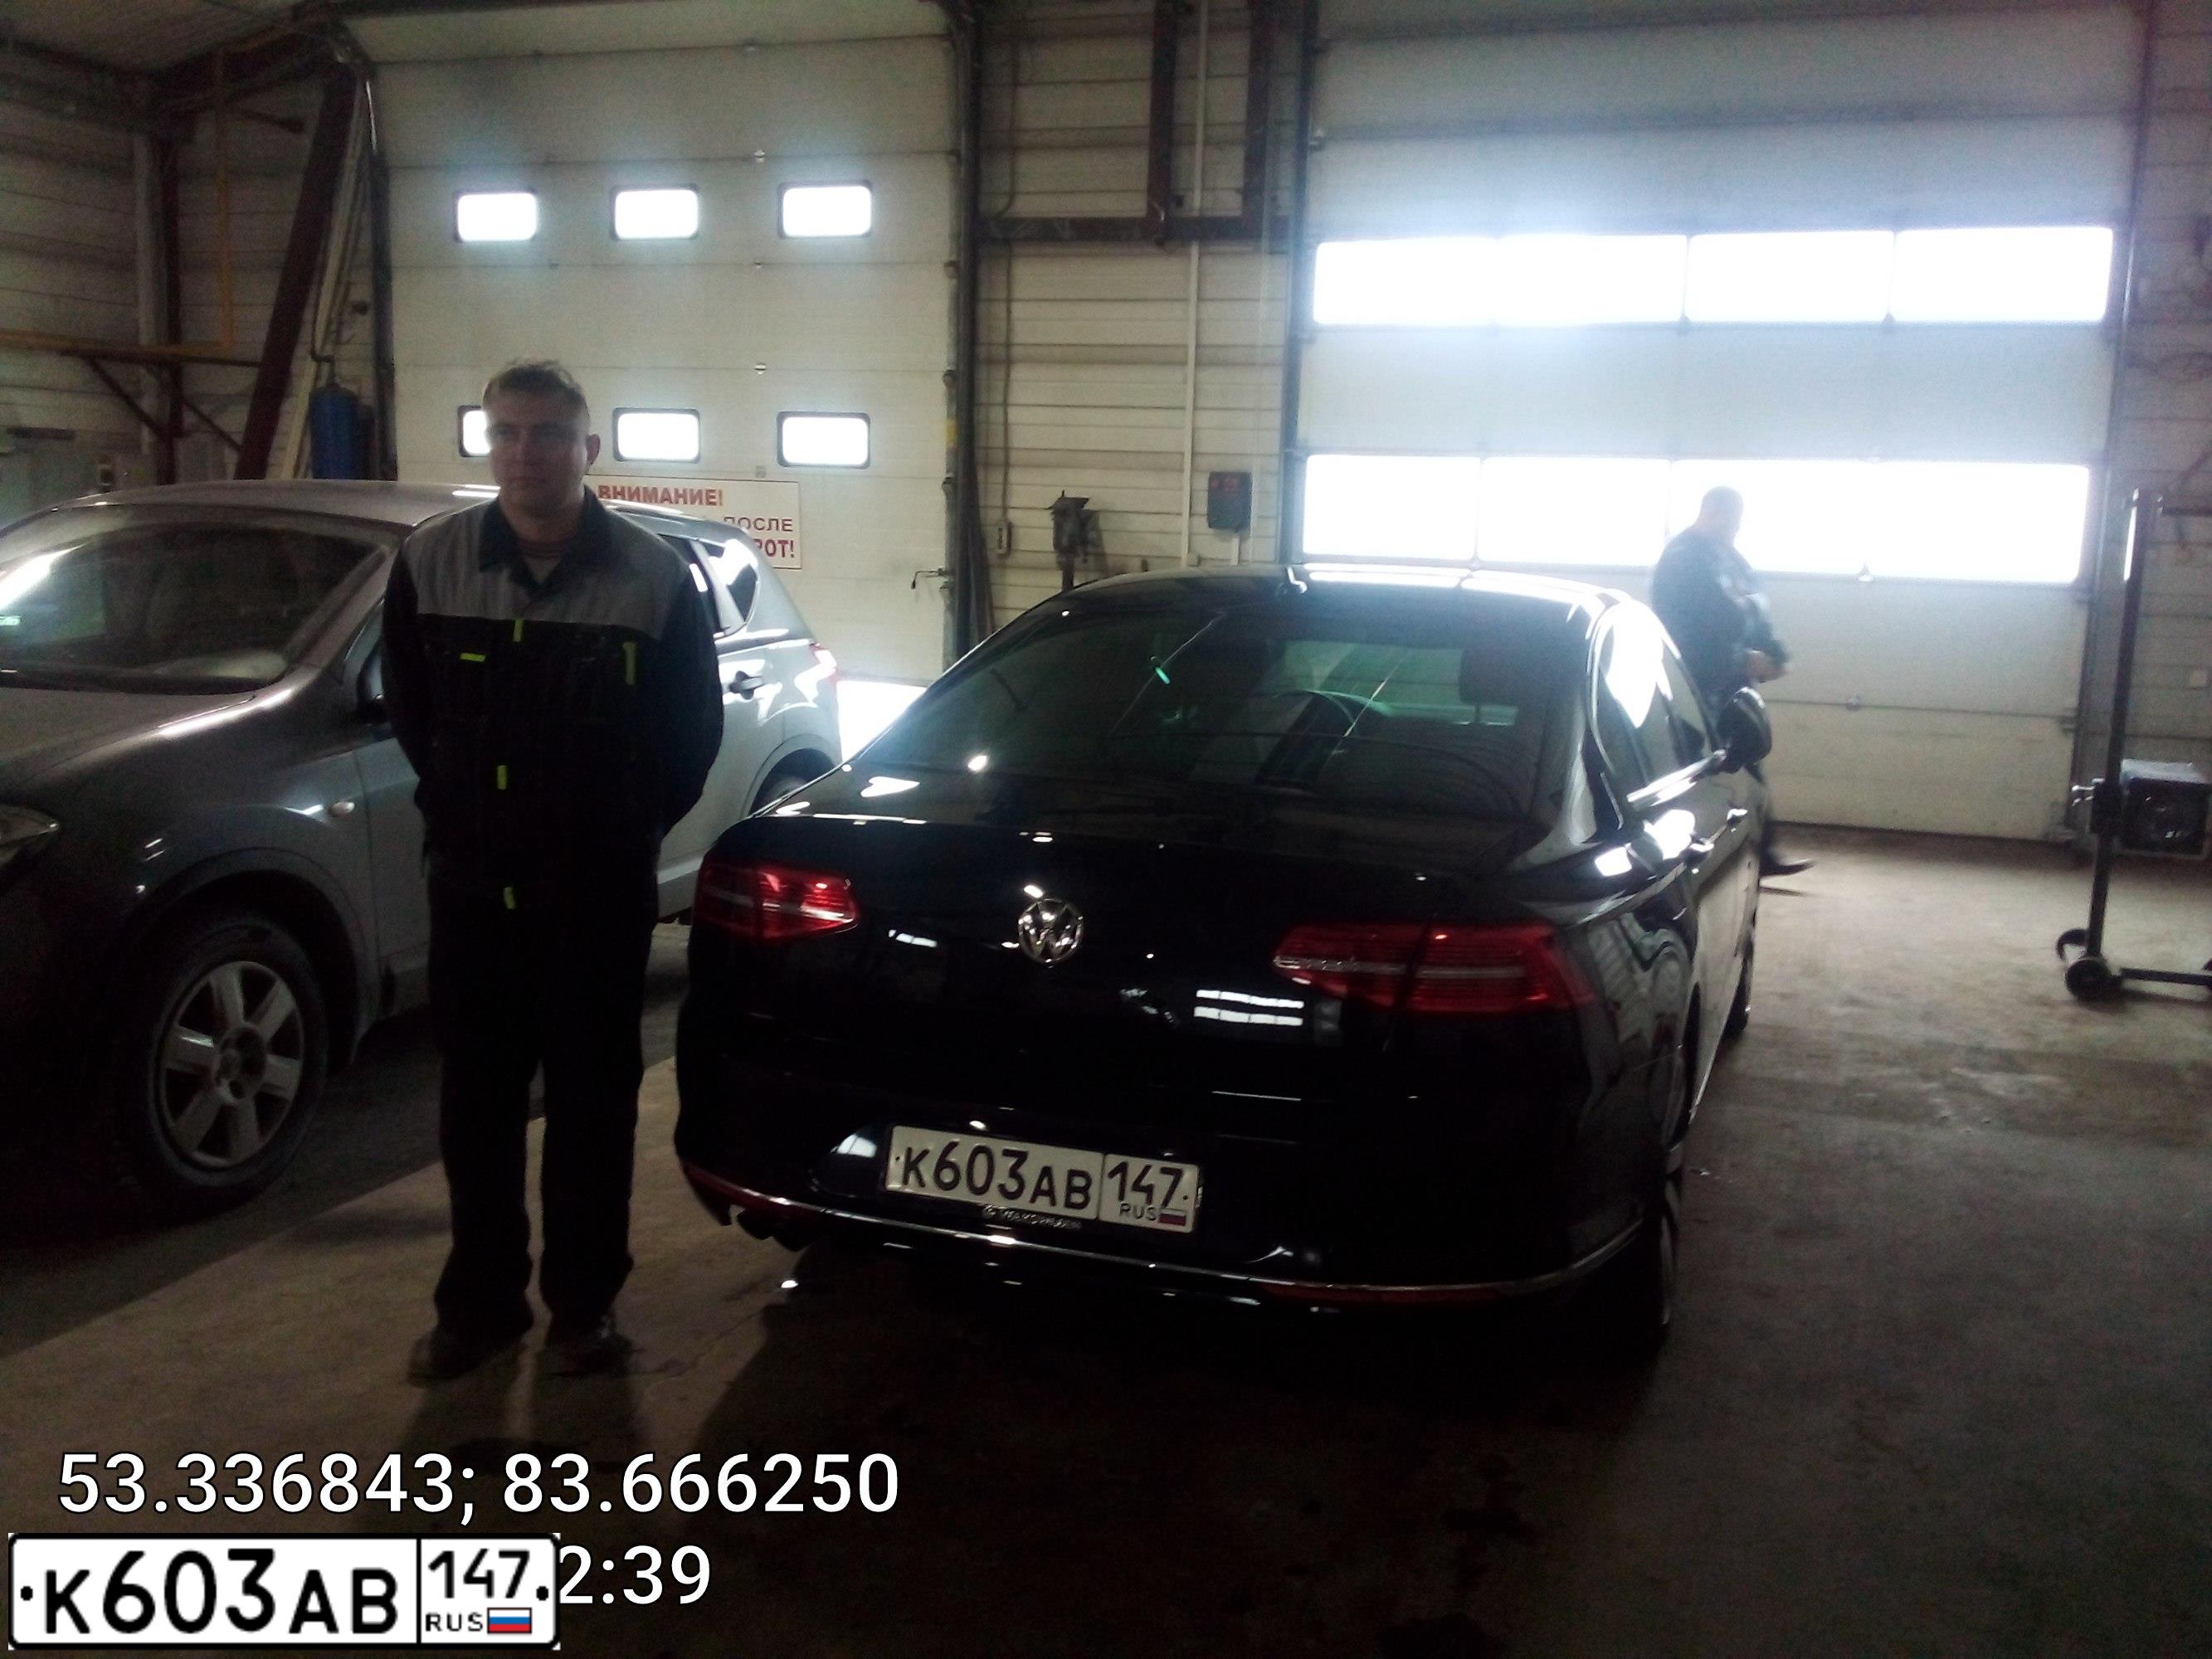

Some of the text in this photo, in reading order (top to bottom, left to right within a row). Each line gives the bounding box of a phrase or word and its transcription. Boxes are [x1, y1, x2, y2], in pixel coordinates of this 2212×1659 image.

[597, 484, 724, 507] ВНИМАНИЕ!
[903, 1140, 1183, 1209] К603АВ 147
[1119, 1203, 1159, 1222] RUS
